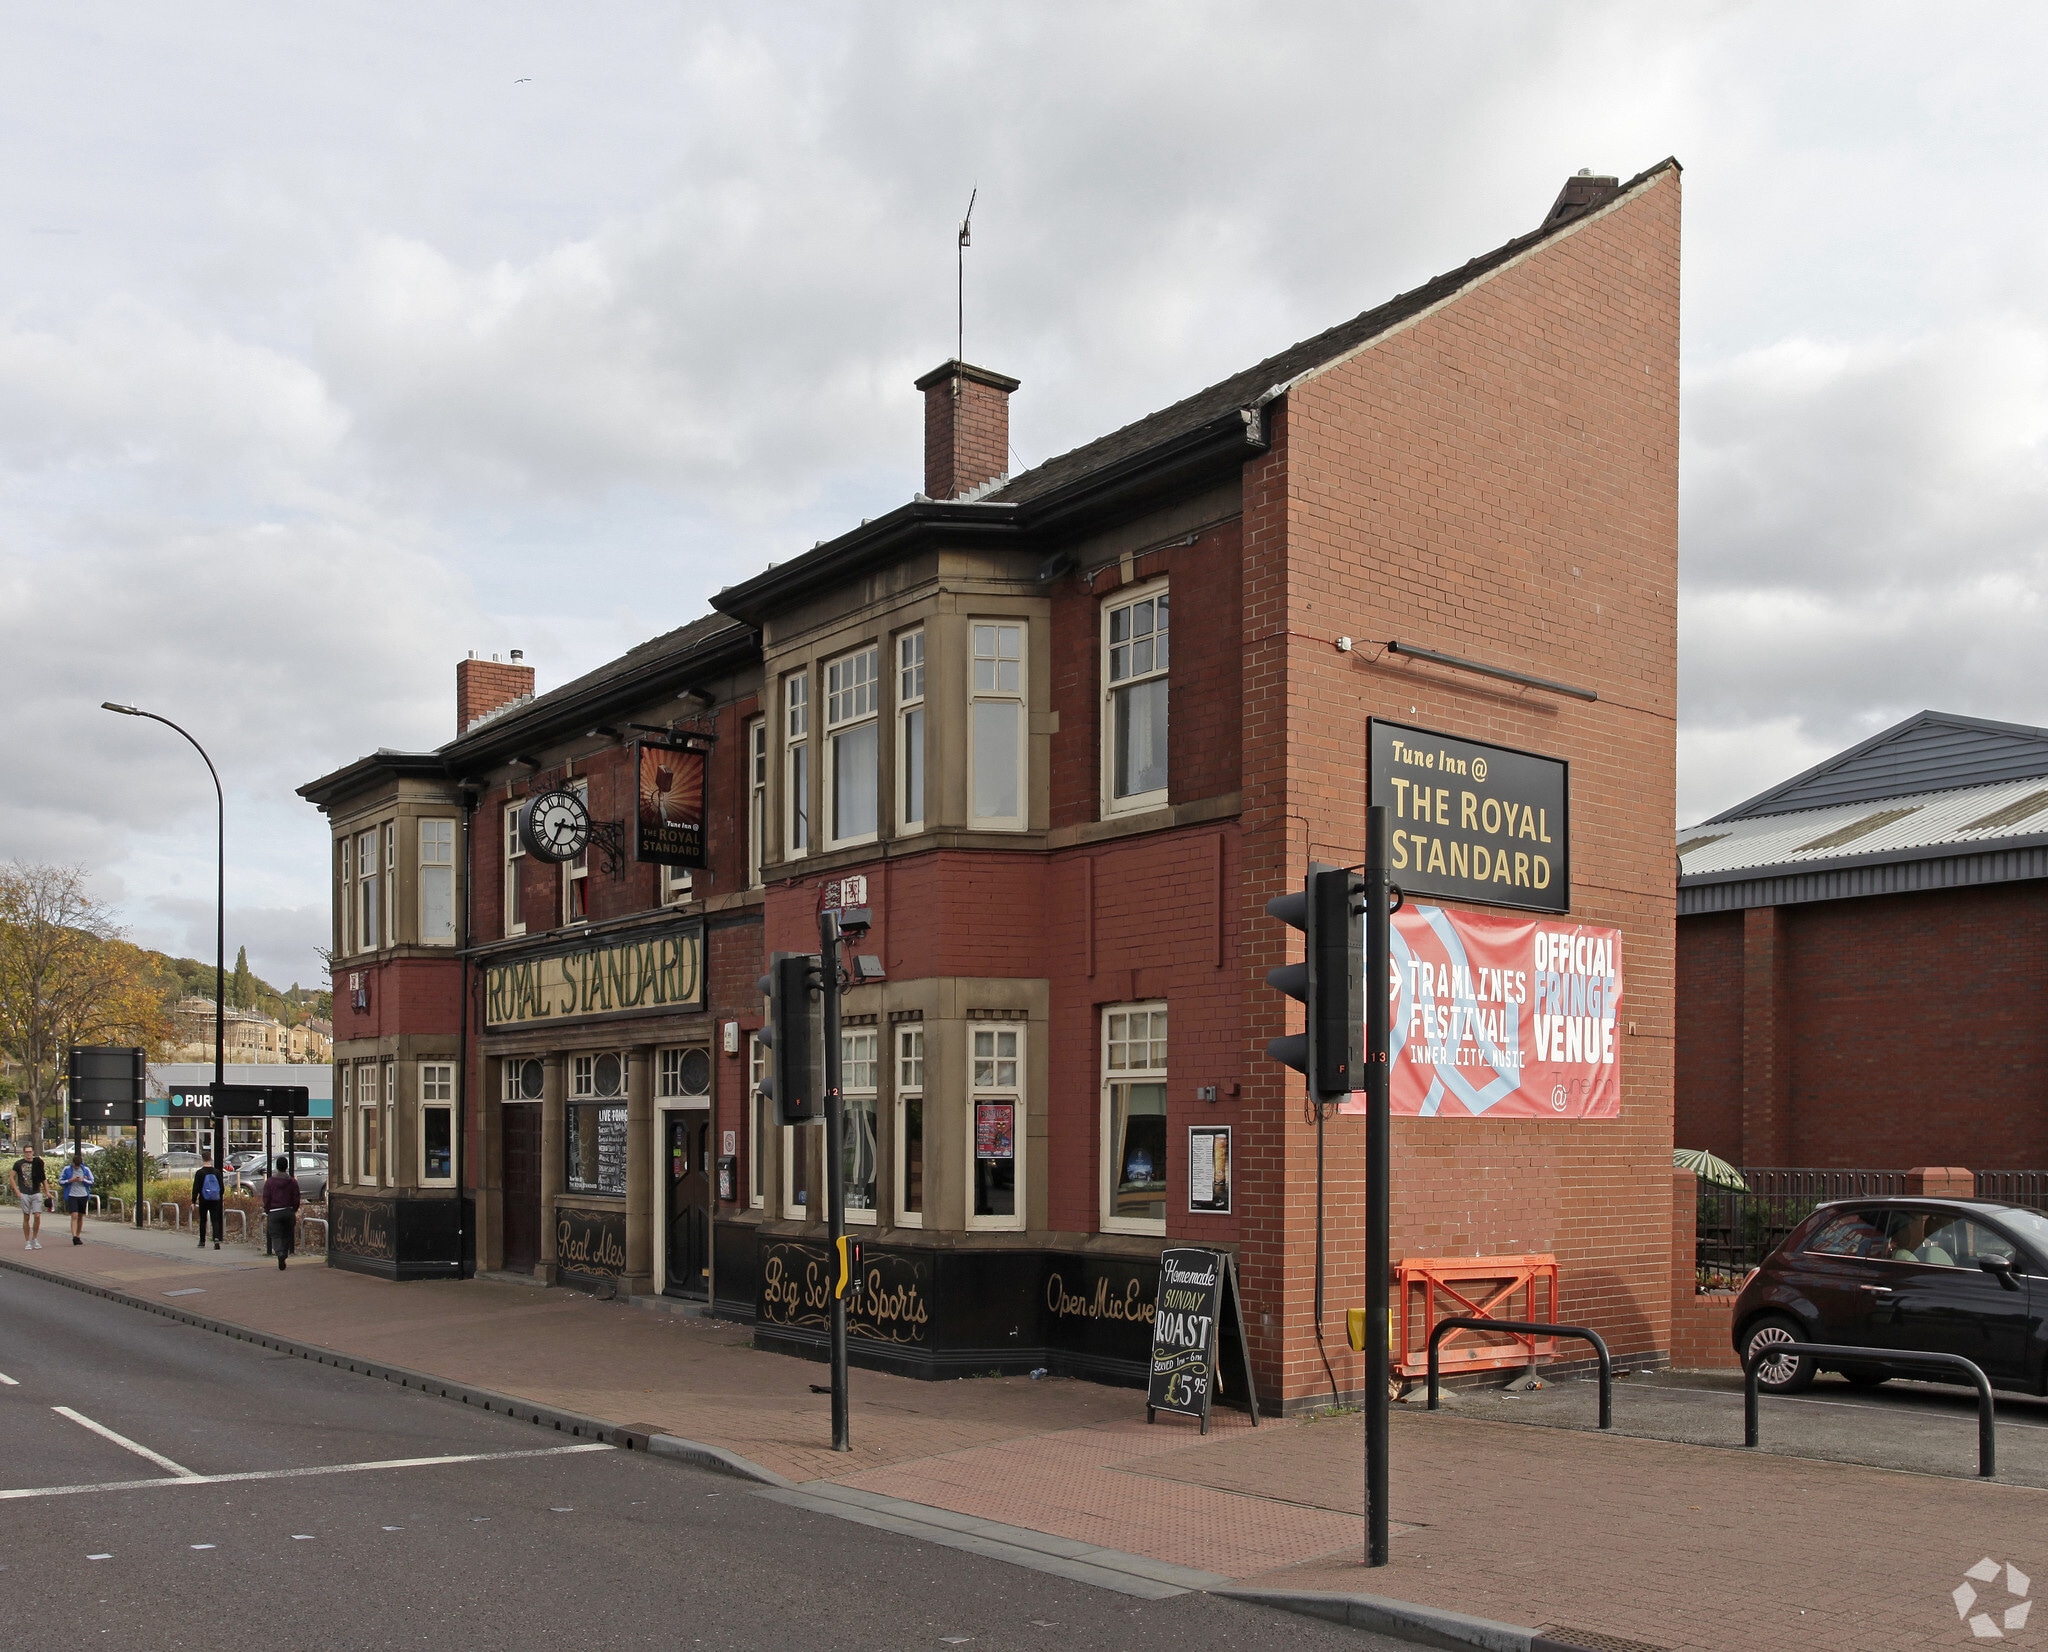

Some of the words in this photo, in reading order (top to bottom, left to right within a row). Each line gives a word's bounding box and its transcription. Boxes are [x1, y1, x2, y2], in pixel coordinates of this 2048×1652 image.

[1391, 740, 1434, 769] Tune
[1438, 750, 1467, 776] Inn
[1471, 757, 1488, 783] @
[1391, 778, 1450, 826] THE
[1461, 791, 1552, 843] ROYAL
[643, 828, 657, 837] THE
[659, 828, 700, 845] ROYAL
[643, 840, 700, 856] STANDARD
[1391, 829, 1551, 890] STANDARD
[1534, 931, 1616, 978] OFFICIAL
[488, 956, 551, 1022] ROYAL
[561, 934, 697, 1014] STANDARD
[1407, 960, 1527, 1005] TRAMLINES
[1534, 970, 1616, 1018] FRINGE
[1410, 1003, 1511, 1043] FESTIVAL
[1533, 1013, 1616, 1065] VENUE
[359, 1211, 387, 1249] Music
[558, 1220, 590, 1261] Real
[593, 1224, 625, 1267] Ales
[765, 1256, 800, 1316] Big
[867, 1268, 929, 1325] Sports
[1047, 1272, 1087, 1318] Open
[1088, 1276, 1124, 1319] Mic
[1164, 1258, 1216, 1287] Homemade
[1163, 1288, 1206, 1312] SUNDAY
[1156, 1309, 1212, 1349] ROAST
